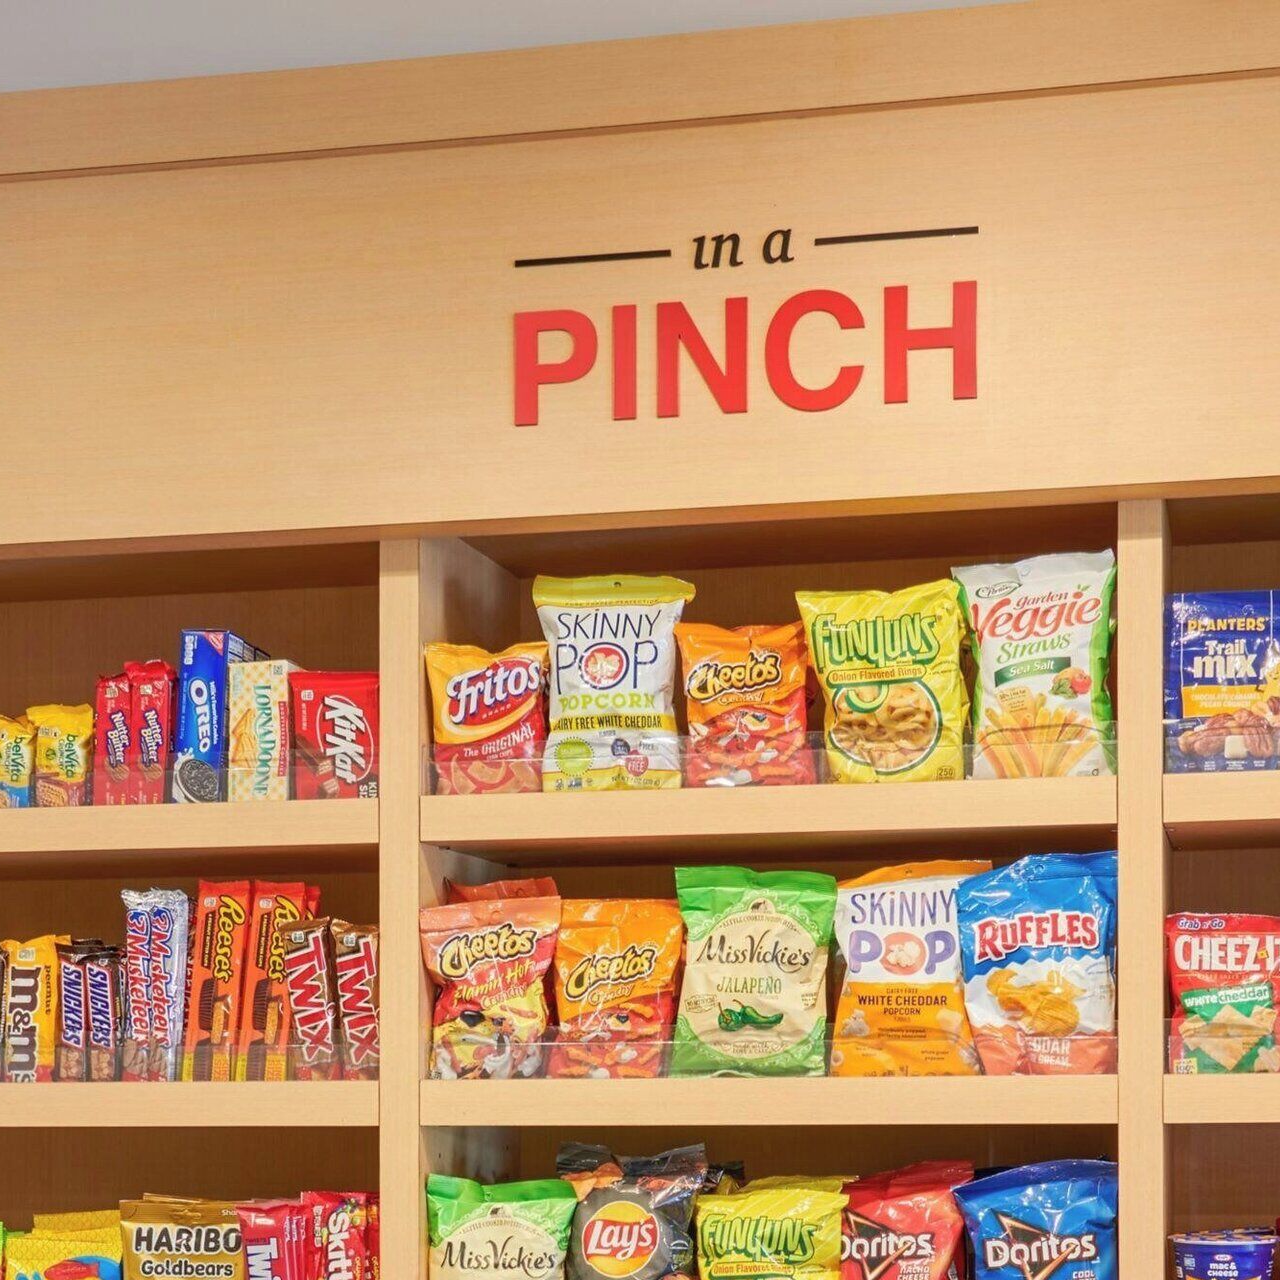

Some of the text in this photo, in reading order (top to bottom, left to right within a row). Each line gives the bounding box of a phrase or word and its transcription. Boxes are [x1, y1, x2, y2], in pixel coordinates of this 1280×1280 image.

[692, 228, 795, 270] in a
[513, 279, 978, 427] PINCH
[1017, 590, 1068, 609] garden
[557, 609, 662, 640] SKINNY
[971, 594, 1101, 646] Veggie
[1188, 618, 1265, 632] PLANTERS
[996, 632, 1071, 664] Straws
[1205, 640, 1246, 656] Trail
[556, 641, 658, 695] POP
[687, 656, 781, 698] Cheetos
[832, 665, 922, 682] Onion Flavored Rings
[1009, 660, 1054, 677] Sea Salt
[1193, 653, 1259, 679] mix
[448, 660, 542, 723] Fritos
[560, 692, 655, 711] POPCORN
[189, 679, 210, 753] OREO
[575, 716, 662, 728] FREE WHITE CHEDDAR
[482, 725, 535, 755] ORIGINAL
[850, 889, 956, 927] SKINNY
[1177, 917, 1225, 929] Grab Go
[213, 895, 246, 982] Reese's
[440, 924, 536, 977] Cheetos
[976, 912, 1098, 960] RUFFLES
[849, 930, 956, 975] POP
[87, 966, 112, 1048] SNICKERS
[286, 930, 333, 1061] TWIX
[337, 937, 378, 1063] TWIX
[858, 995, 947, 1006] WHITE CHEDDAR
[1219, 985, 1269, 1003] cheddar
[134, 1227, 242, 1252] HARIBO
[587, 1220, 655, 1260] Lay's
[987, 1234, 1097, 1267] Doritos
[141, 1260, 233, 1276] Goldbears
[1072, 1271, 1096, 1280] COOL
